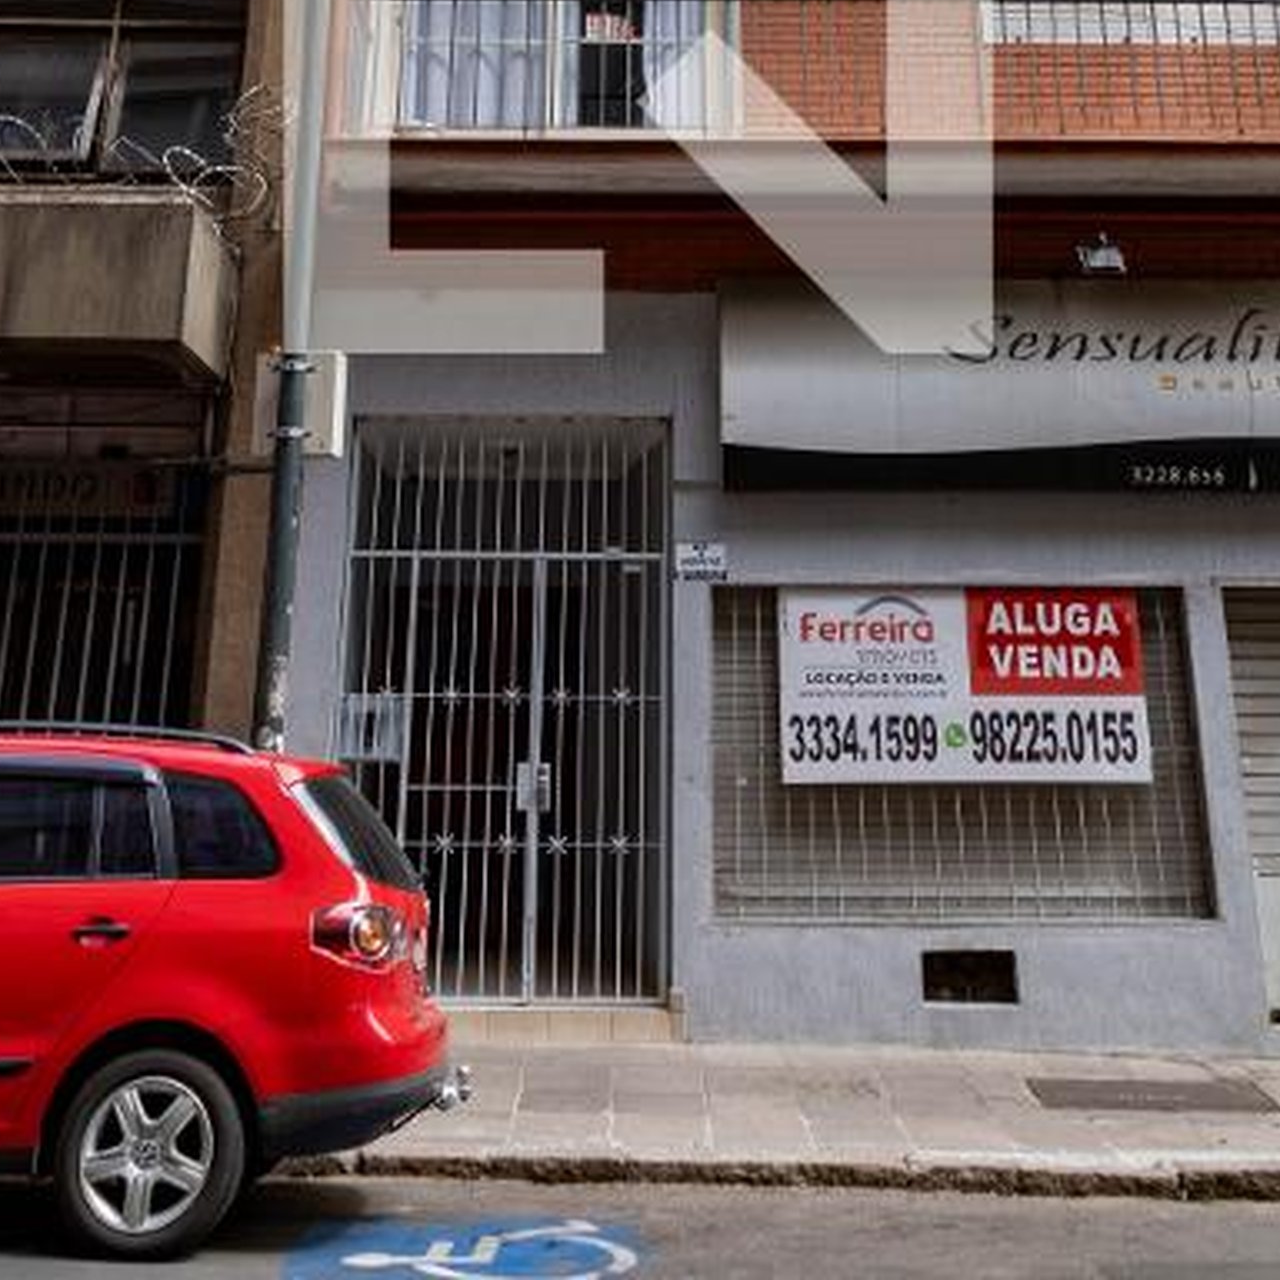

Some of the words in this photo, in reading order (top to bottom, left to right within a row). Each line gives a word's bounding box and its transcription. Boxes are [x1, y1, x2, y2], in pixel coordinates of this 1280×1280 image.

[800, 613, 934, 642] Ferreira
[986, 602, 1121, 636] ALUGA
[805, 670, 877, 687] LOCAÇÃO
[987, 644, 1123, 679] VENDA
[788, 715, 938, 763] 3334.1599
[970, 711, 1138, 764] 98225.0155
